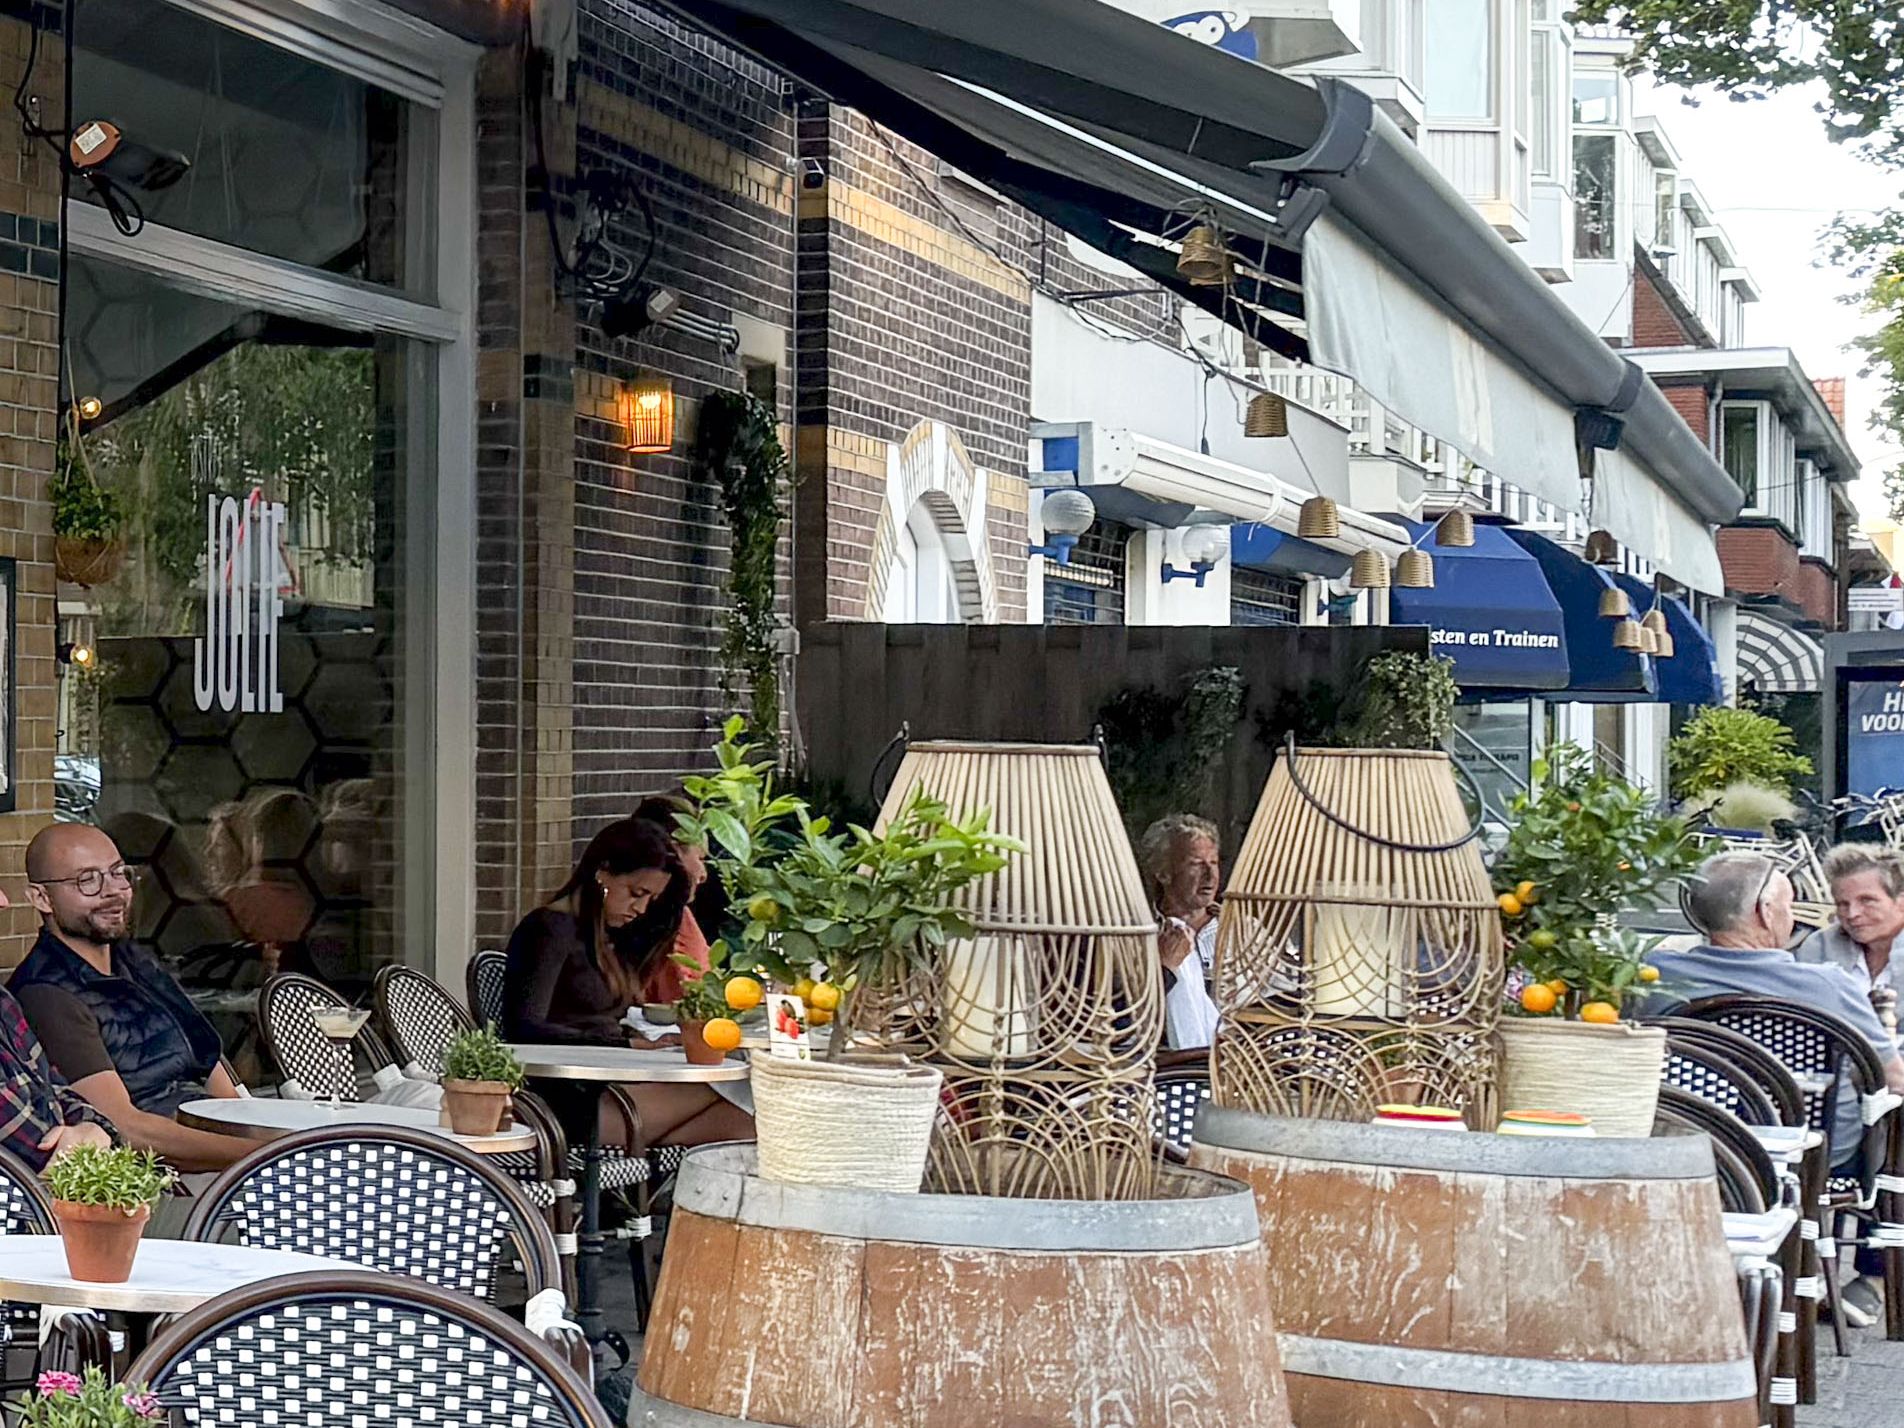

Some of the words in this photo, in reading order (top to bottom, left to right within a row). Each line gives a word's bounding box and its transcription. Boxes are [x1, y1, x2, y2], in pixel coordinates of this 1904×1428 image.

[194, 493, 285, 714] JOLIE
[1469, 630, 1489, 645] en
[1492, 629, 1559, 648] Trainen
